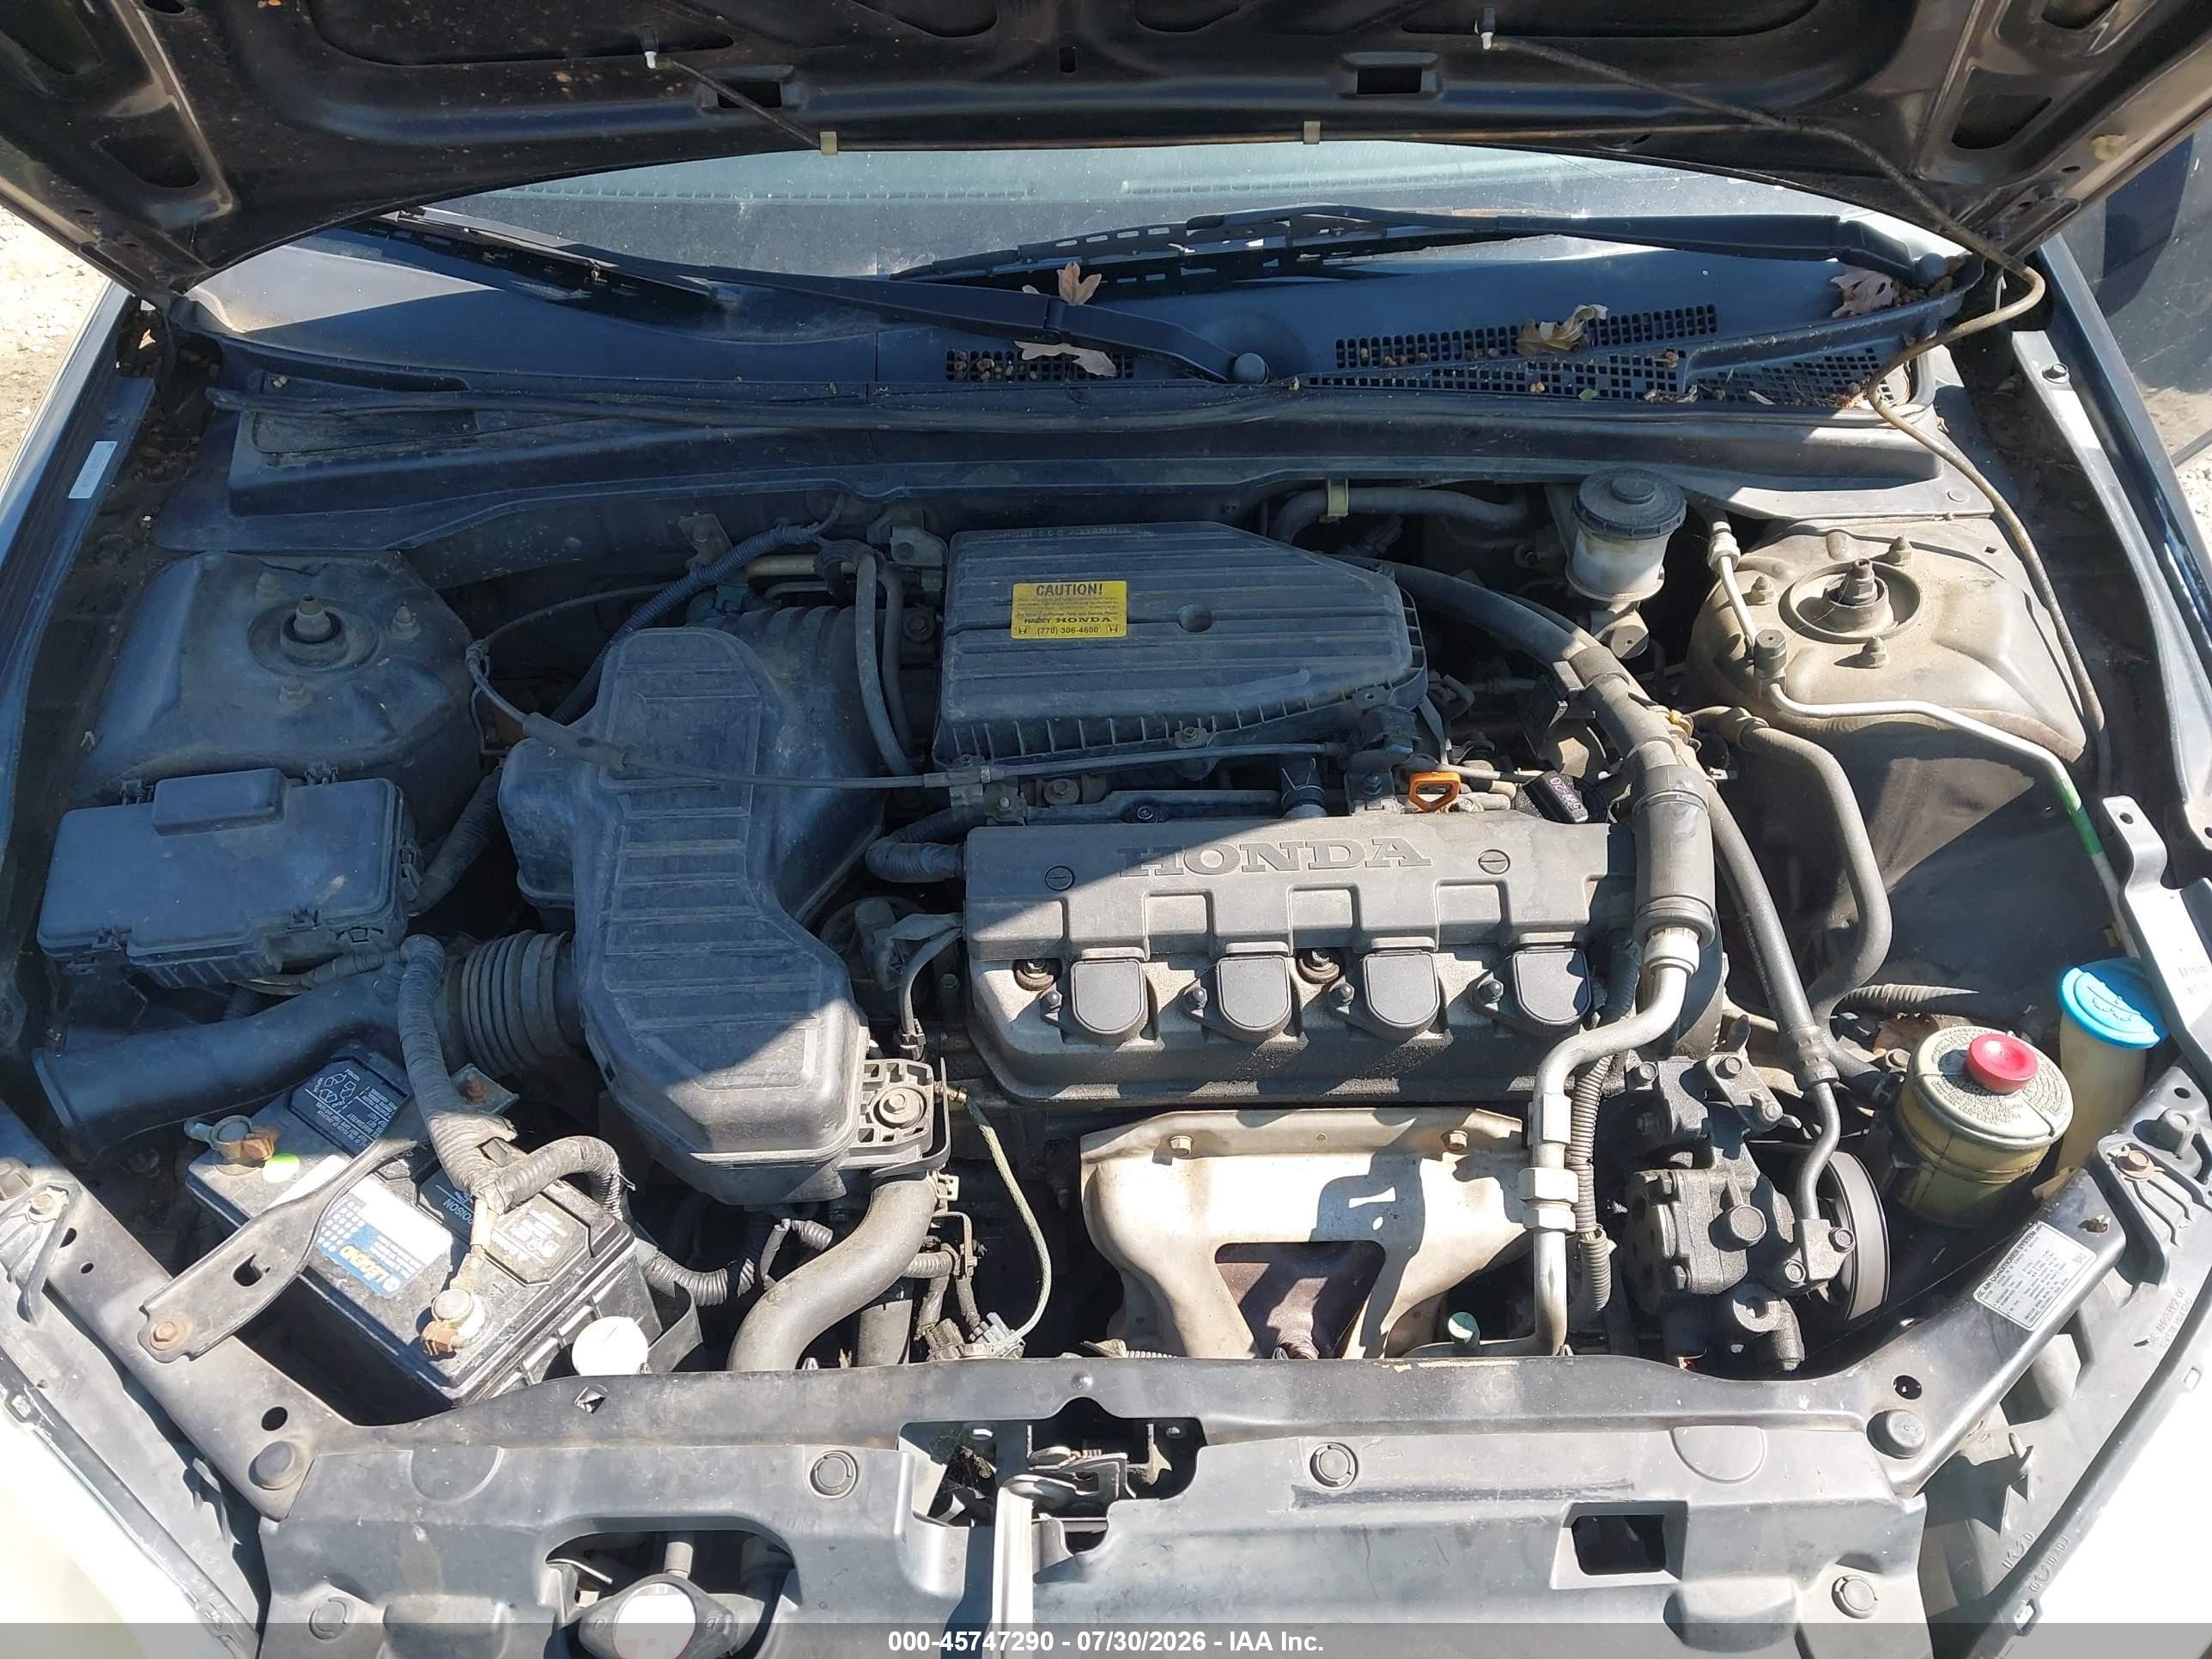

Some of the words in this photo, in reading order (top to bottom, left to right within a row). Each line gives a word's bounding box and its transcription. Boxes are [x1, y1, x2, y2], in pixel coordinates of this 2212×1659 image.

[1036, 583, 1103, 596] CAUTION!
[1119, 837, 1432, 878] HONDA
[1983, 1281, 1992, 1291] AIR
[2017, 1229, 2036, 1250] SYSTEM
